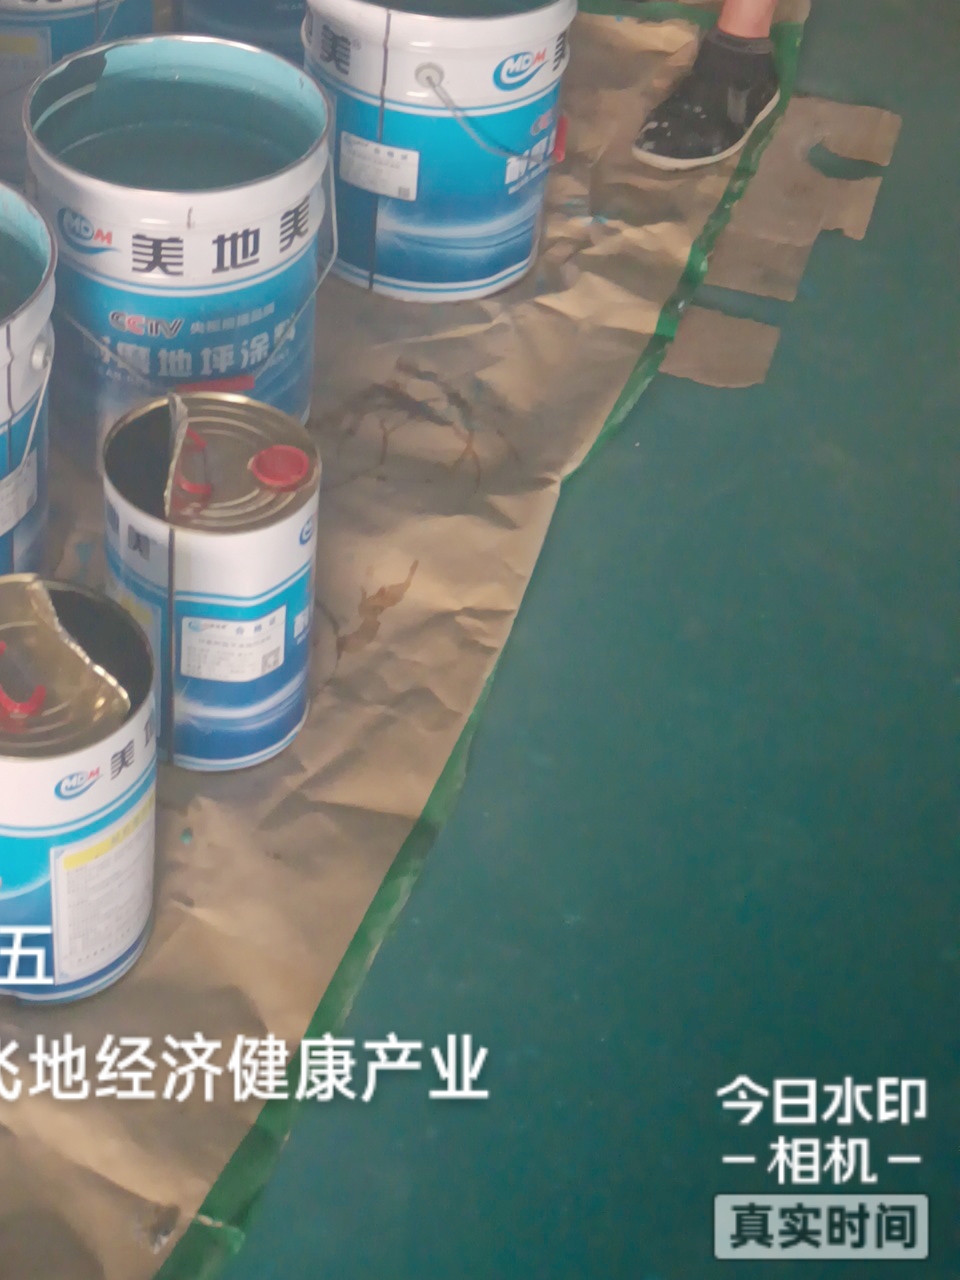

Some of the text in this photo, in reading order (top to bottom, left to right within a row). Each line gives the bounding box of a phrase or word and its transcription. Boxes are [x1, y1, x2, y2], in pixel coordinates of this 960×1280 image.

[131, 194, 310, 276] 美地美
[109, 310, 184, 339] CCTV
